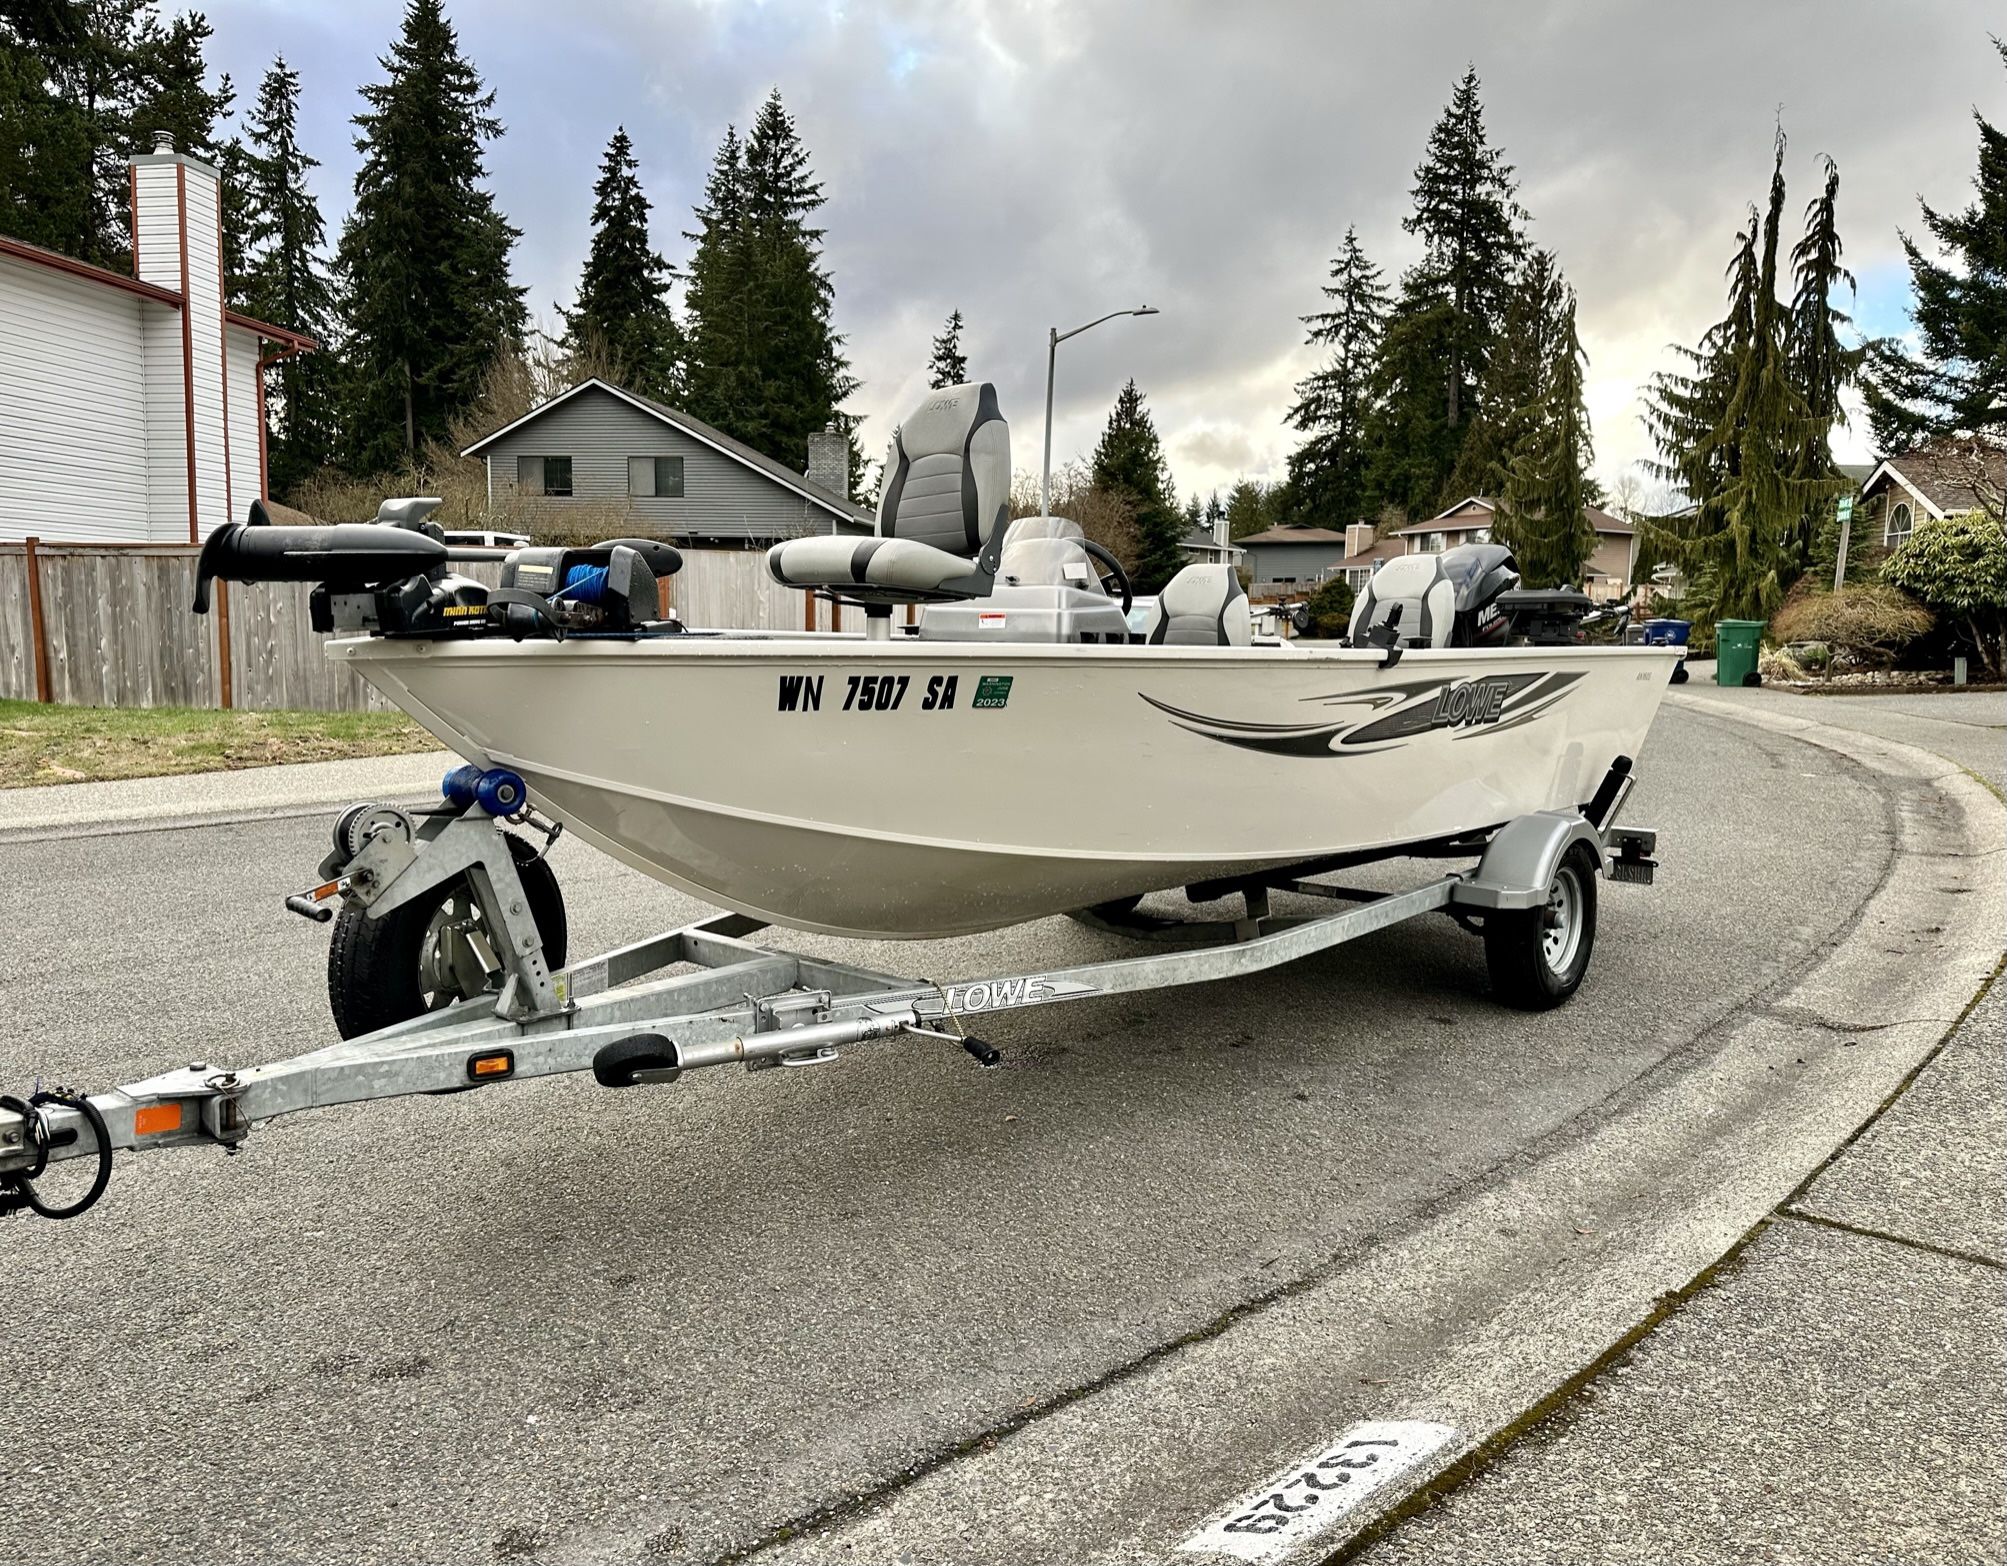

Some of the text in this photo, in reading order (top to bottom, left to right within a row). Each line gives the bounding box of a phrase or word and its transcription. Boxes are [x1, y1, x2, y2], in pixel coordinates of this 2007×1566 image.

[778, 675, 958, 712] WN 7507 SA
[976, 698, 1005, 707] 2023
[1431, 682, 1508, 728] LOWE
[941, 975, 1047, 1016] LOWE
[1223, 1439, 1399, 1535] 13229
